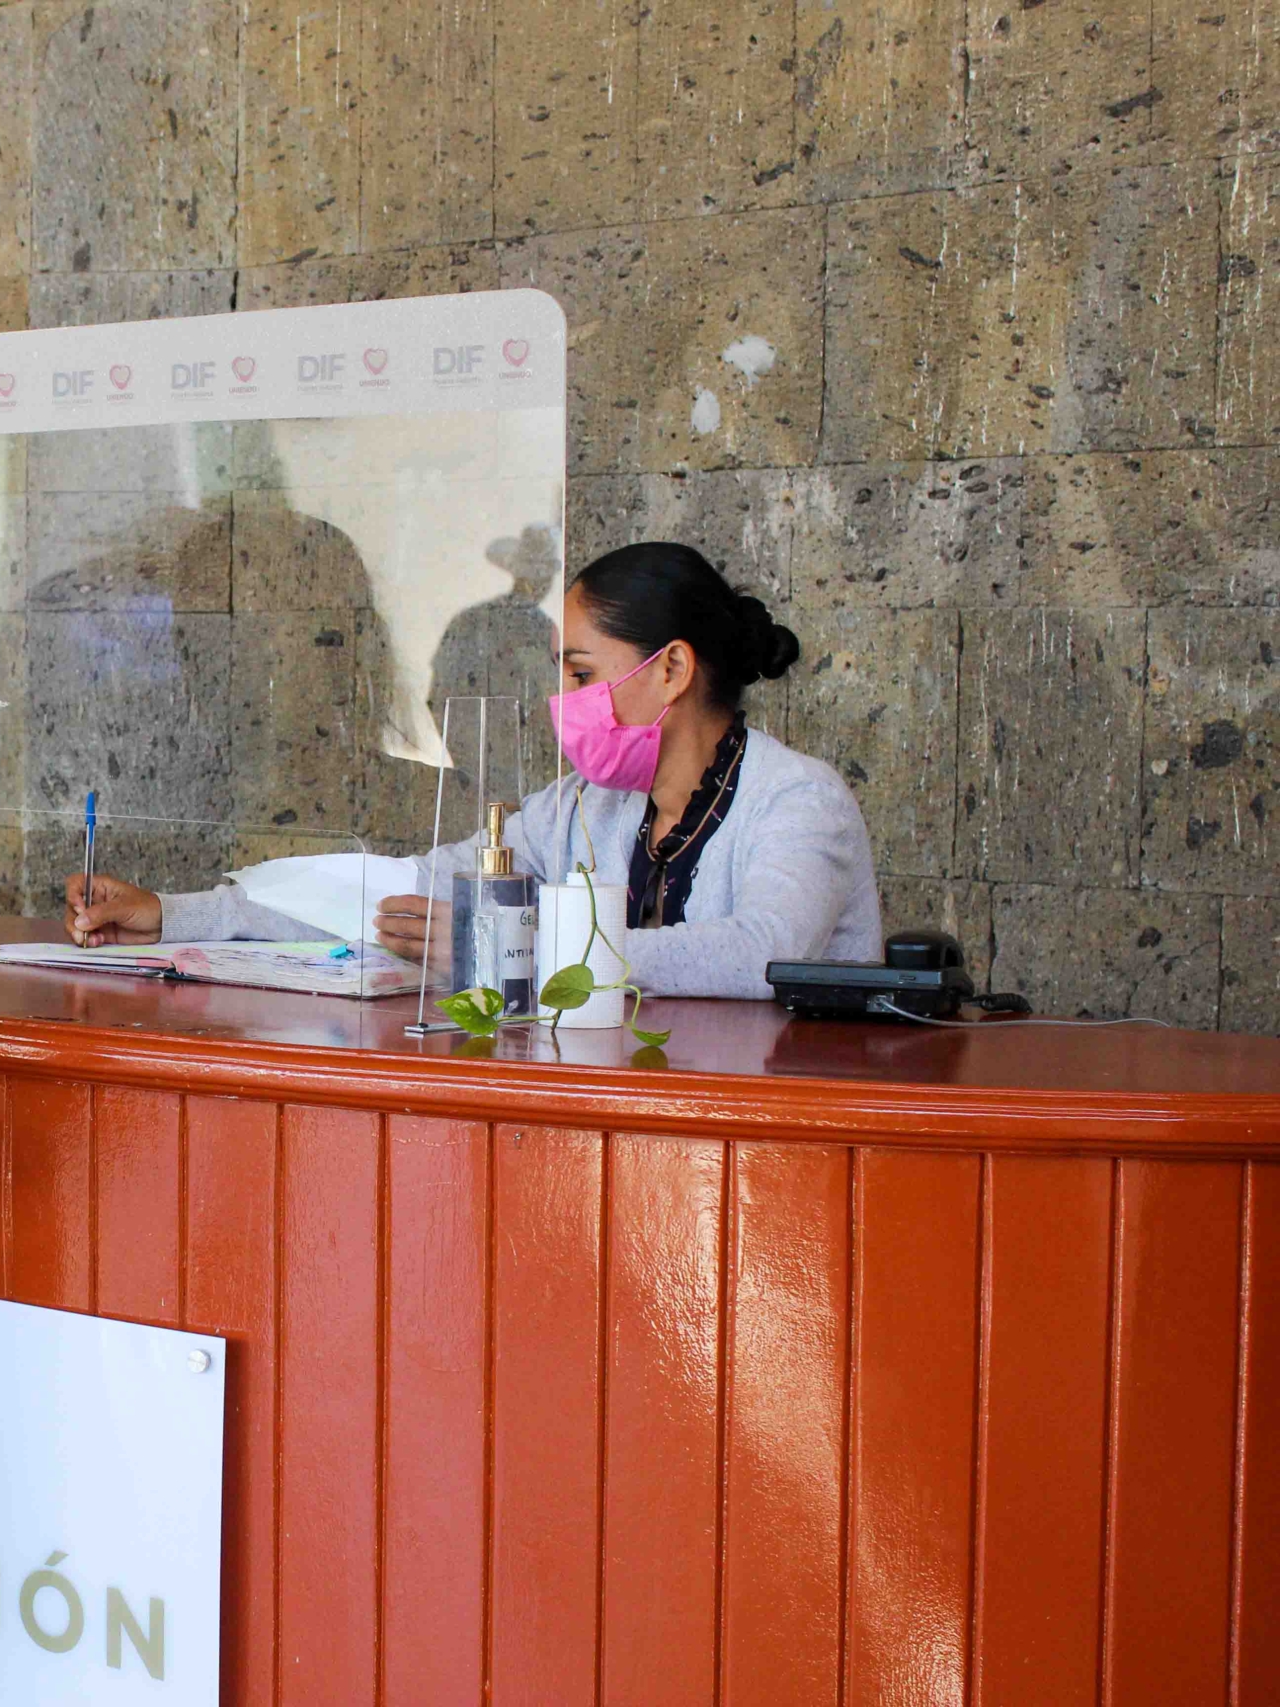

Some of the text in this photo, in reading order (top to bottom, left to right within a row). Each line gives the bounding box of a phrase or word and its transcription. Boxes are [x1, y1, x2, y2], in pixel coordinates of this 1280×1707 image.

[297, 353, 345, 382] DIF
[433, 345, 484, 375] DIF
[52, 370, 94, 397] DIF
[171, 361, 216, 390] DIF
